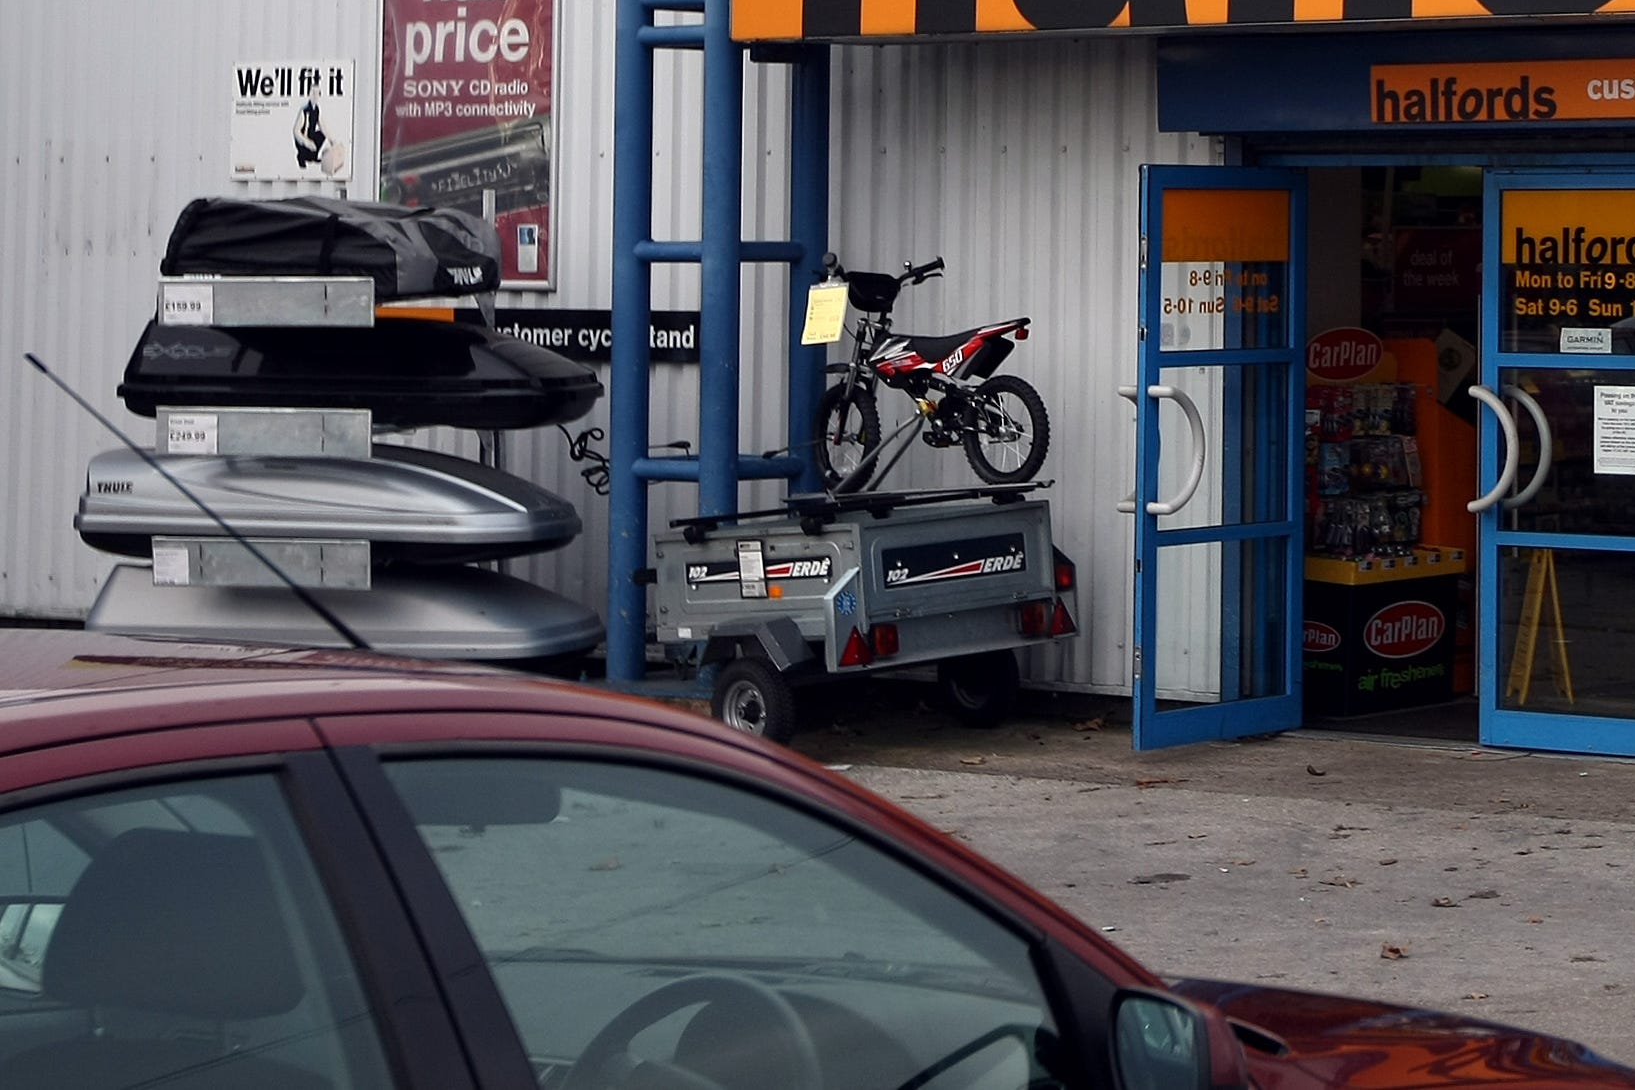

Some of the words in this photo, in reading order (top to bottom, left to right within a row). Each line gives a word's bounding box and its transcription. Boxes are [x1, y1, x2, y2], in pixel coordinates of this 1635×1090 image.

[404, 7, 530, 77] price
[237, 68, 292, 97] We'll
[298, 68, 321, 97] fit
[328, 68, 344, 97] it
[403, 80, 465, 98] SONY
[469, 80, 491, 97] CD
[494, 78, 528, 96] radio
[1376, 75, 1557, 122] halfords
[396, 101, 421, 117] with
[424, 101, 452, 117] MP3
[456, 100, 536, 118] connectivity
[1410, 249, 1436, 266] deal
[1439, 249, 1454, 267] of
[1403, 269, 1423, 287] the
[1427, 269, 1461, 287] week
[1516, 271, 1551, 288] Mon
[1557, 271, 1574, 288] to
[1580, 271, 1601, 288] Fri
[1515, 298, 1543, 315] Sat
[1550, 299, 1578, 316] 9-6
[1588, 299, 1622, 316] Sun
[497, 322, 572, 347] stomer
[577, 327, 612, 351] cyc
[650, 324, 695, 349] tand
[1566, 335, 1604, 344] GARMIN
[942, 349, 964, 373] 650
[1308, 341, 1377, 369] CarPlan
[689, 566, 708, 578] 102
[886, 567, 909, 583] 102
[1304, 628, 1336, 646] rPlan
[1370, 615, 1439, 646] CarPlan
